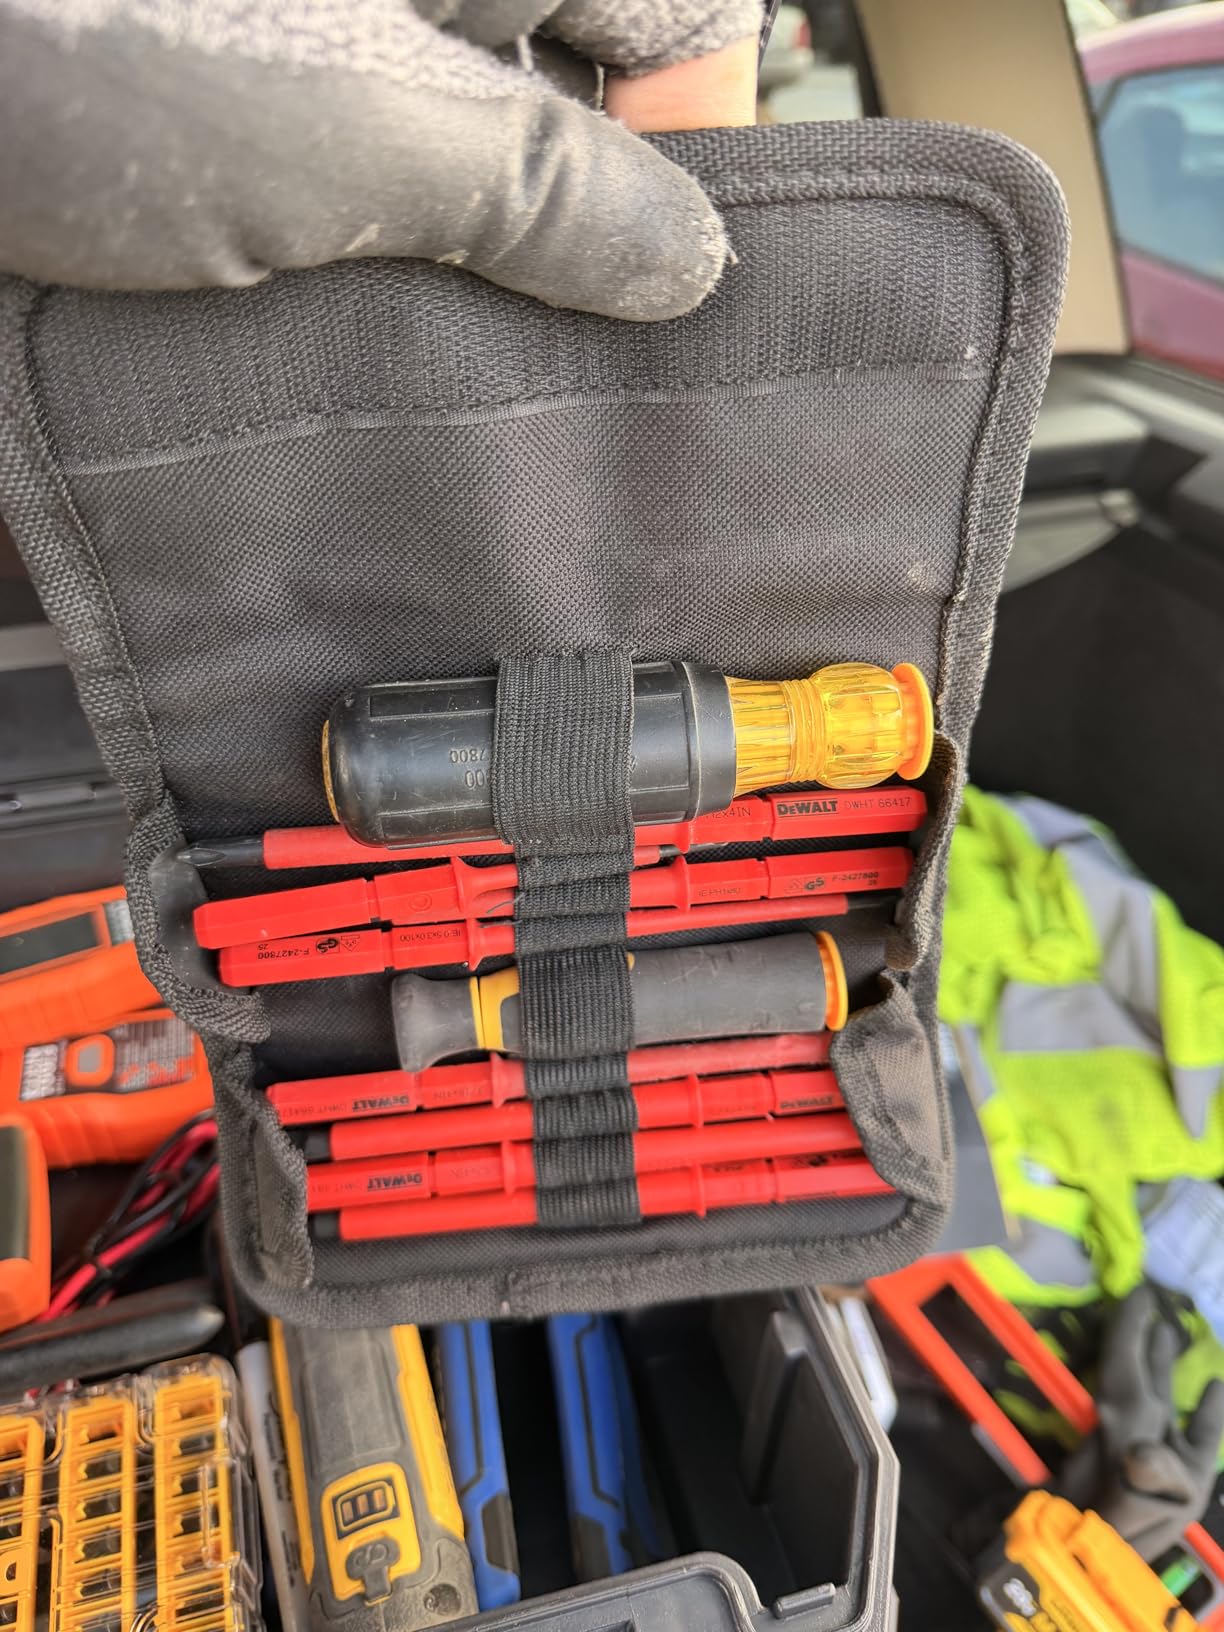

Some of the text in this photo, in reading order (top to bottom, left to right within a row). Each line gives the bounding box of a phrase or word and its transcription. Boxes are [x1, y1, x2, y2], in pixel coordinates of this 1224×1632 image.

[449, 747, 490, 763] 7800
[845, 799, 874, 811] DWHT
[877, 796, 912, 809] 66417
[316, 938, 339, 954] GS
[257, 948, 309, 960] F-2427800
